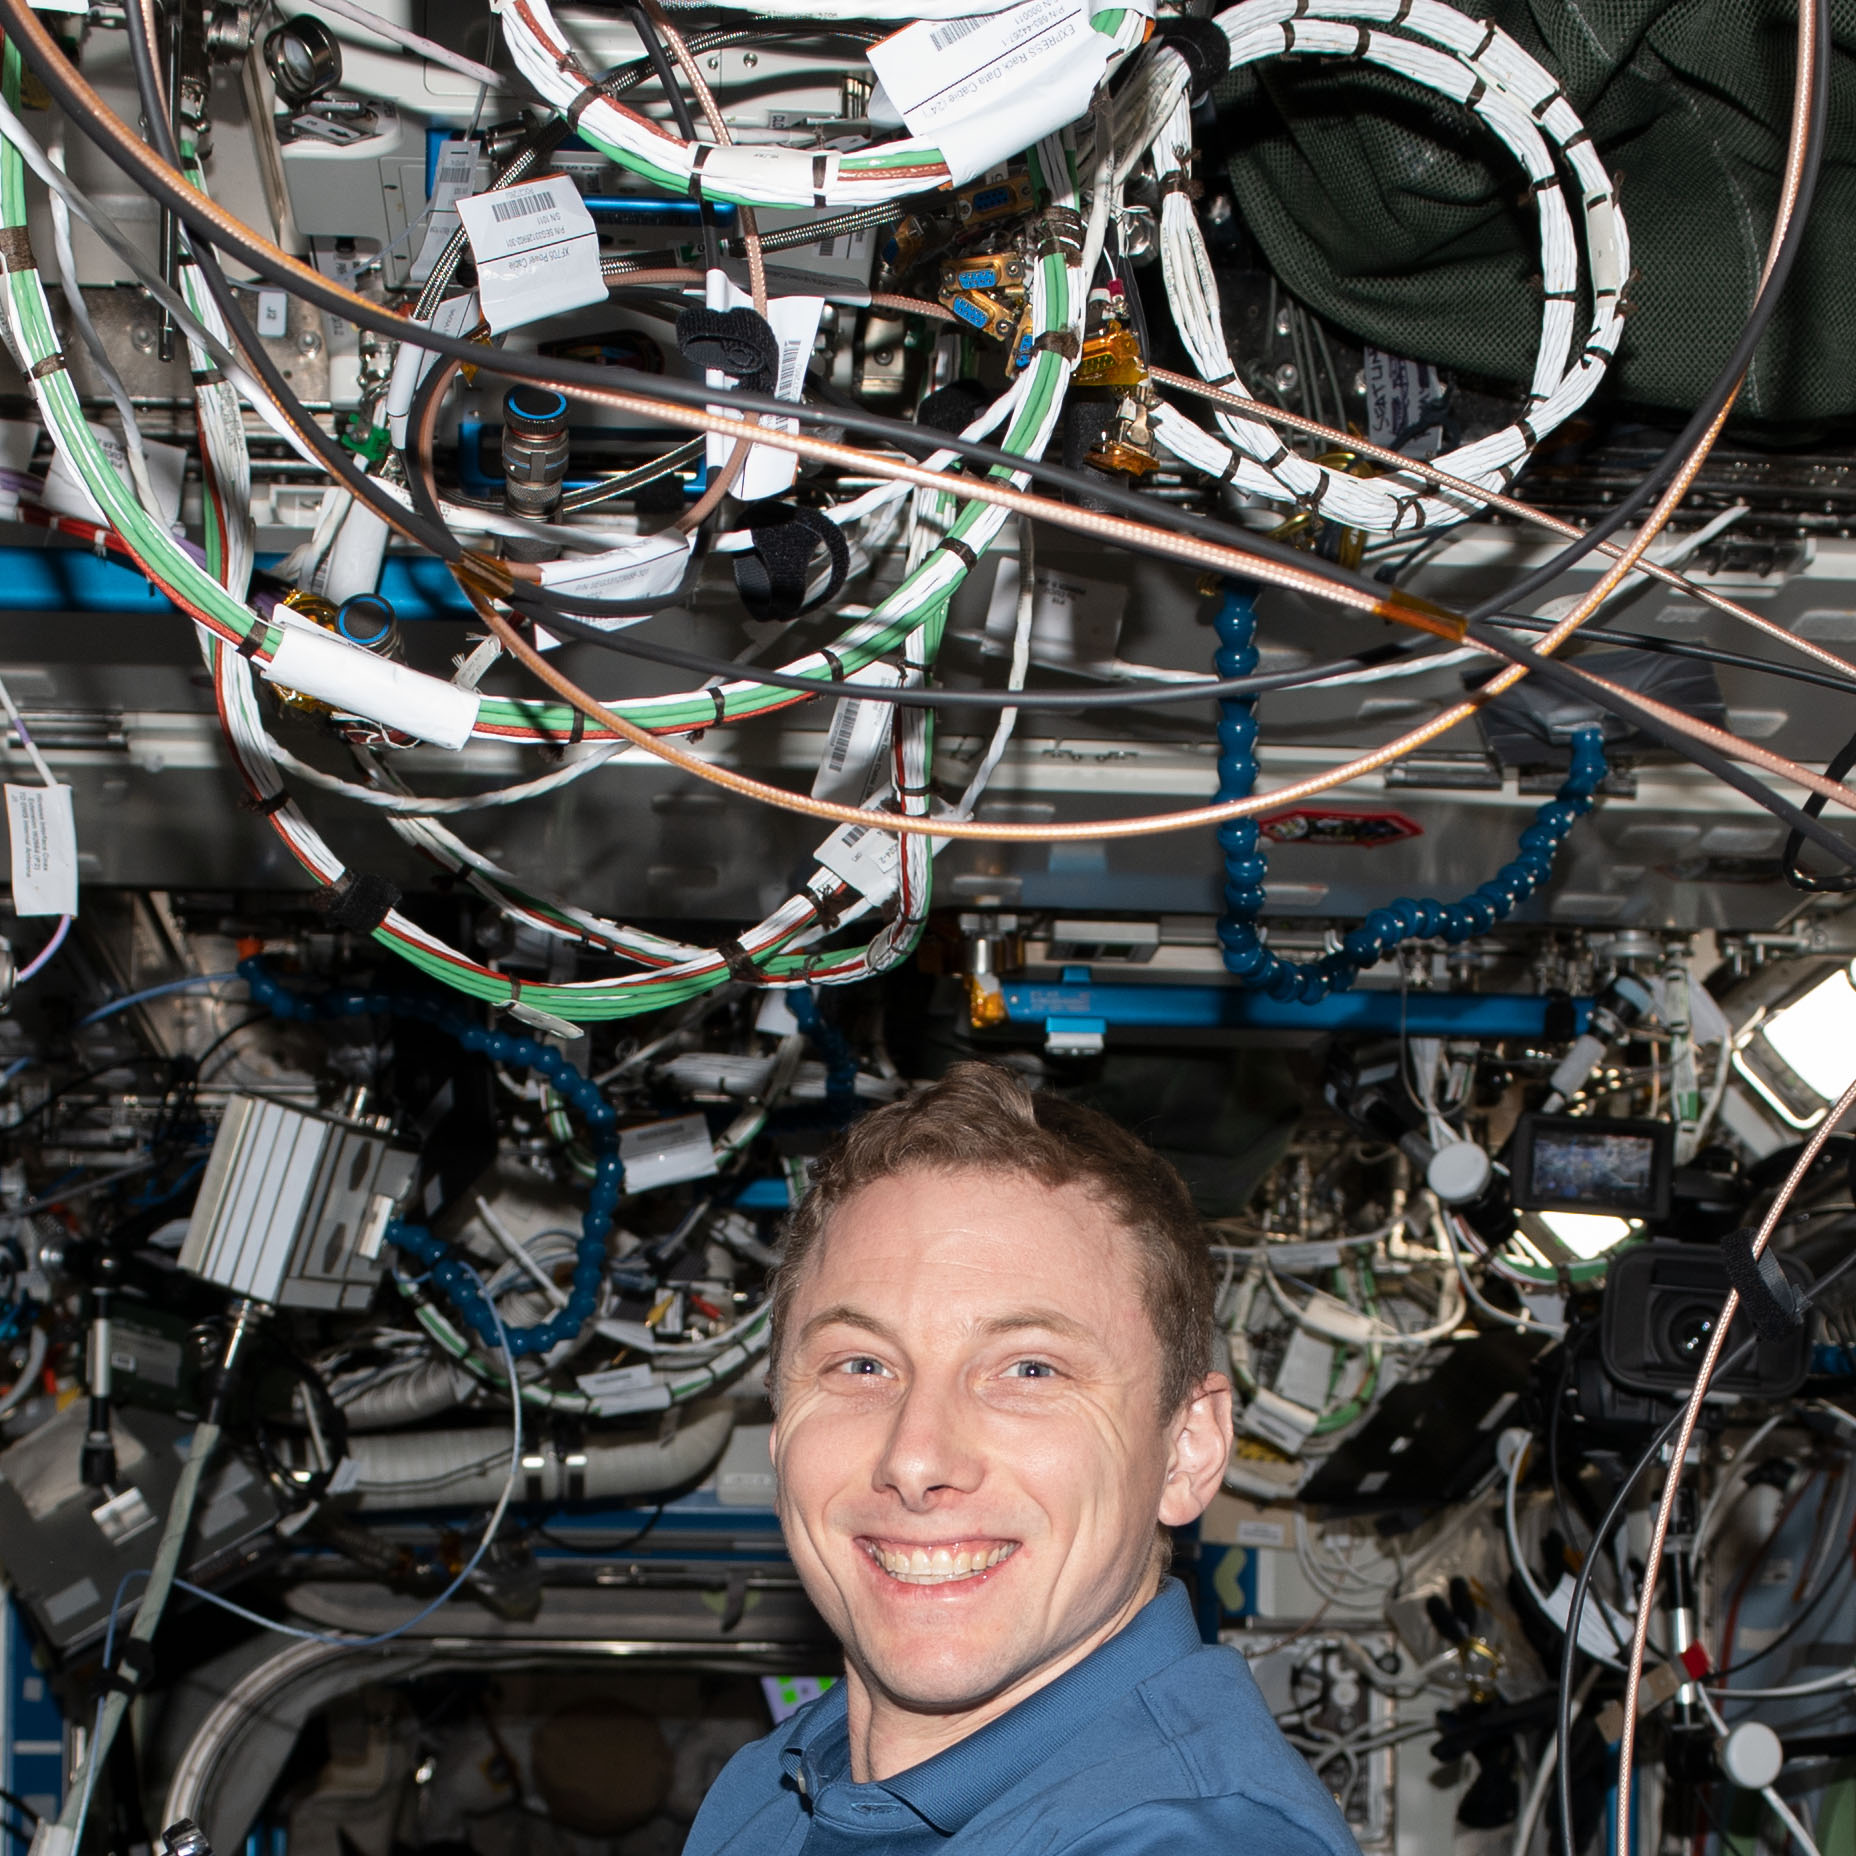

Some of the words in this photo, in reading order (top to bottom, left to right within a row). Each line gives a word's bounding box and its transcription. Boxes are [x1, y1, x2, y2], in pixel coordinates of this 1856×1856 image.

[1026, 22, 1075, 56] EXPRESS
[1003, 52, 1028, 72] Rack
[977, 67, 1003, 87] Data
[947, 81, 978, 105] Cable
[509, 258, 528, 269] Cable
[528, 252, 549, 264] Power
